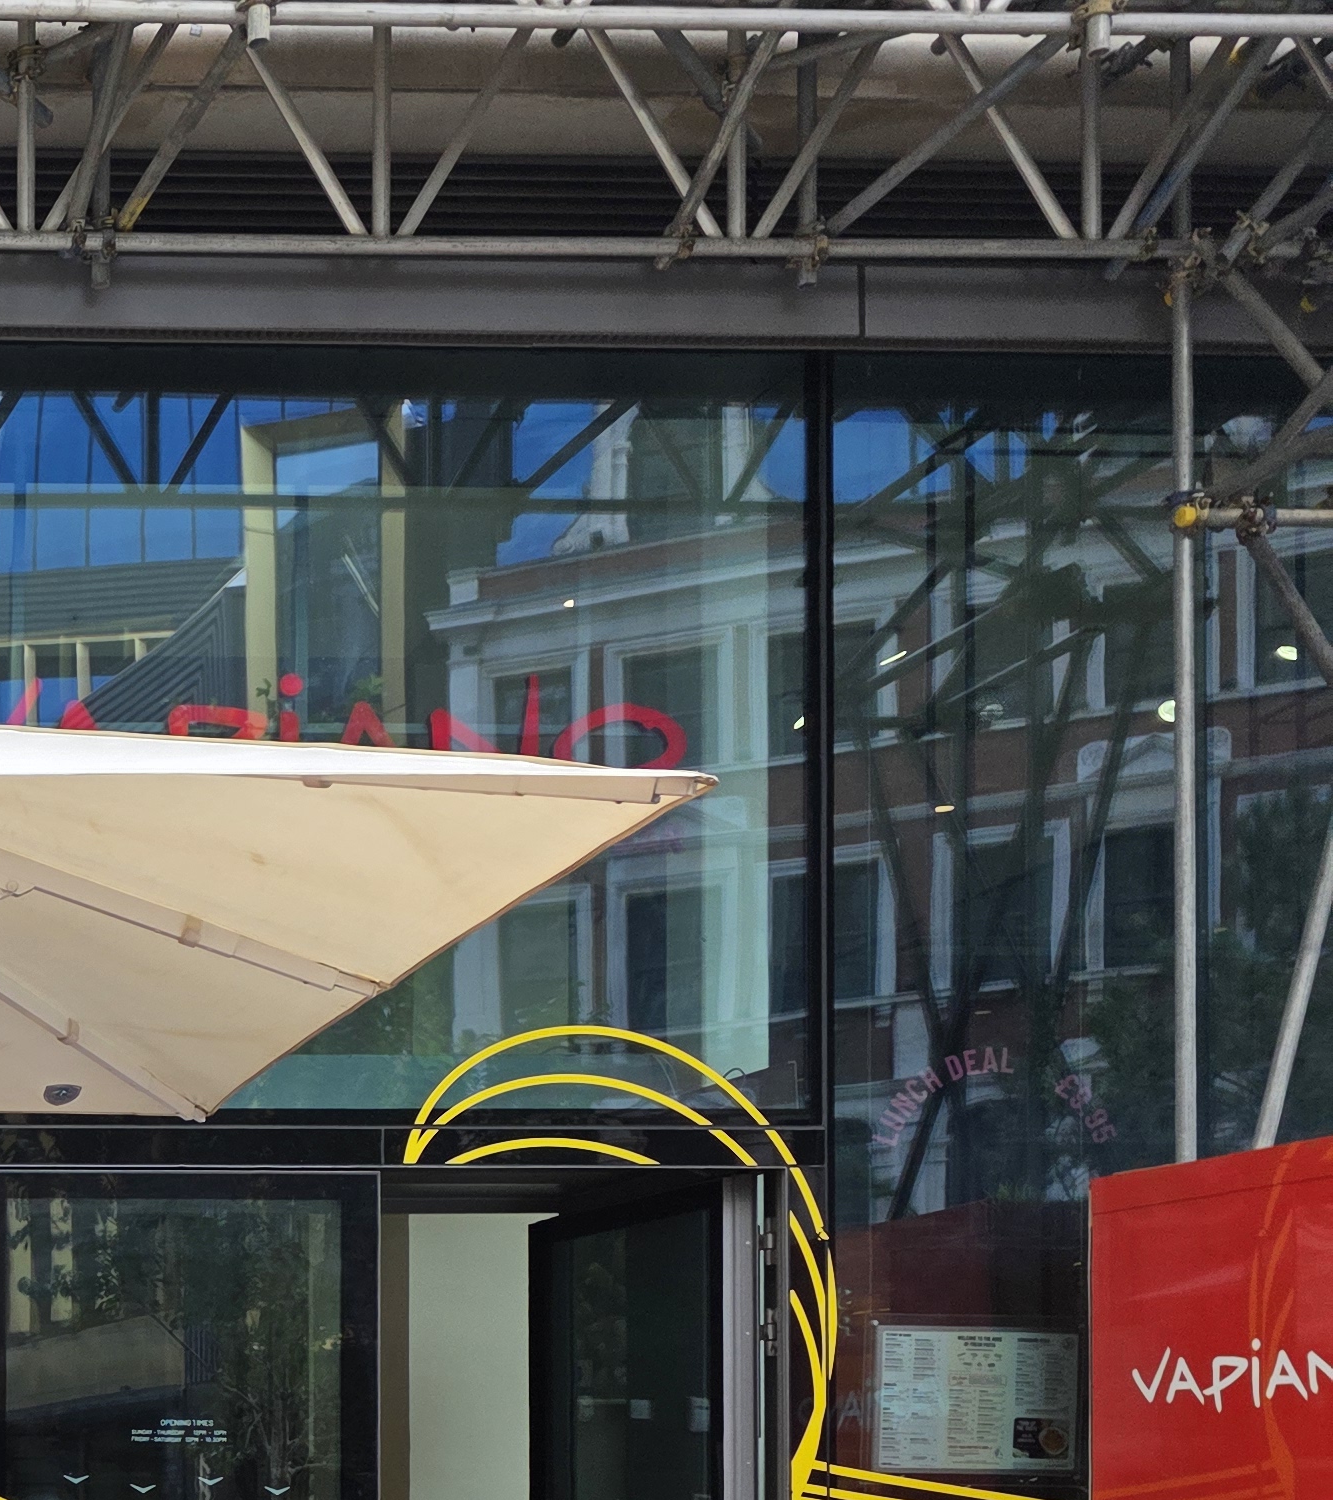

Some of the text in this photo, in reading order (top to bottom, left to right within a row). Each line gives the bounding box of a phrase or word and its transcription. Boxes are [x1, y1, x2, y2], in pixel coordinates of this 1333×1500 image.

[872, 1046, 1015, 1148] LUNCH DEAL
[1131, 1338, 1333, 1414] VAPiAN
